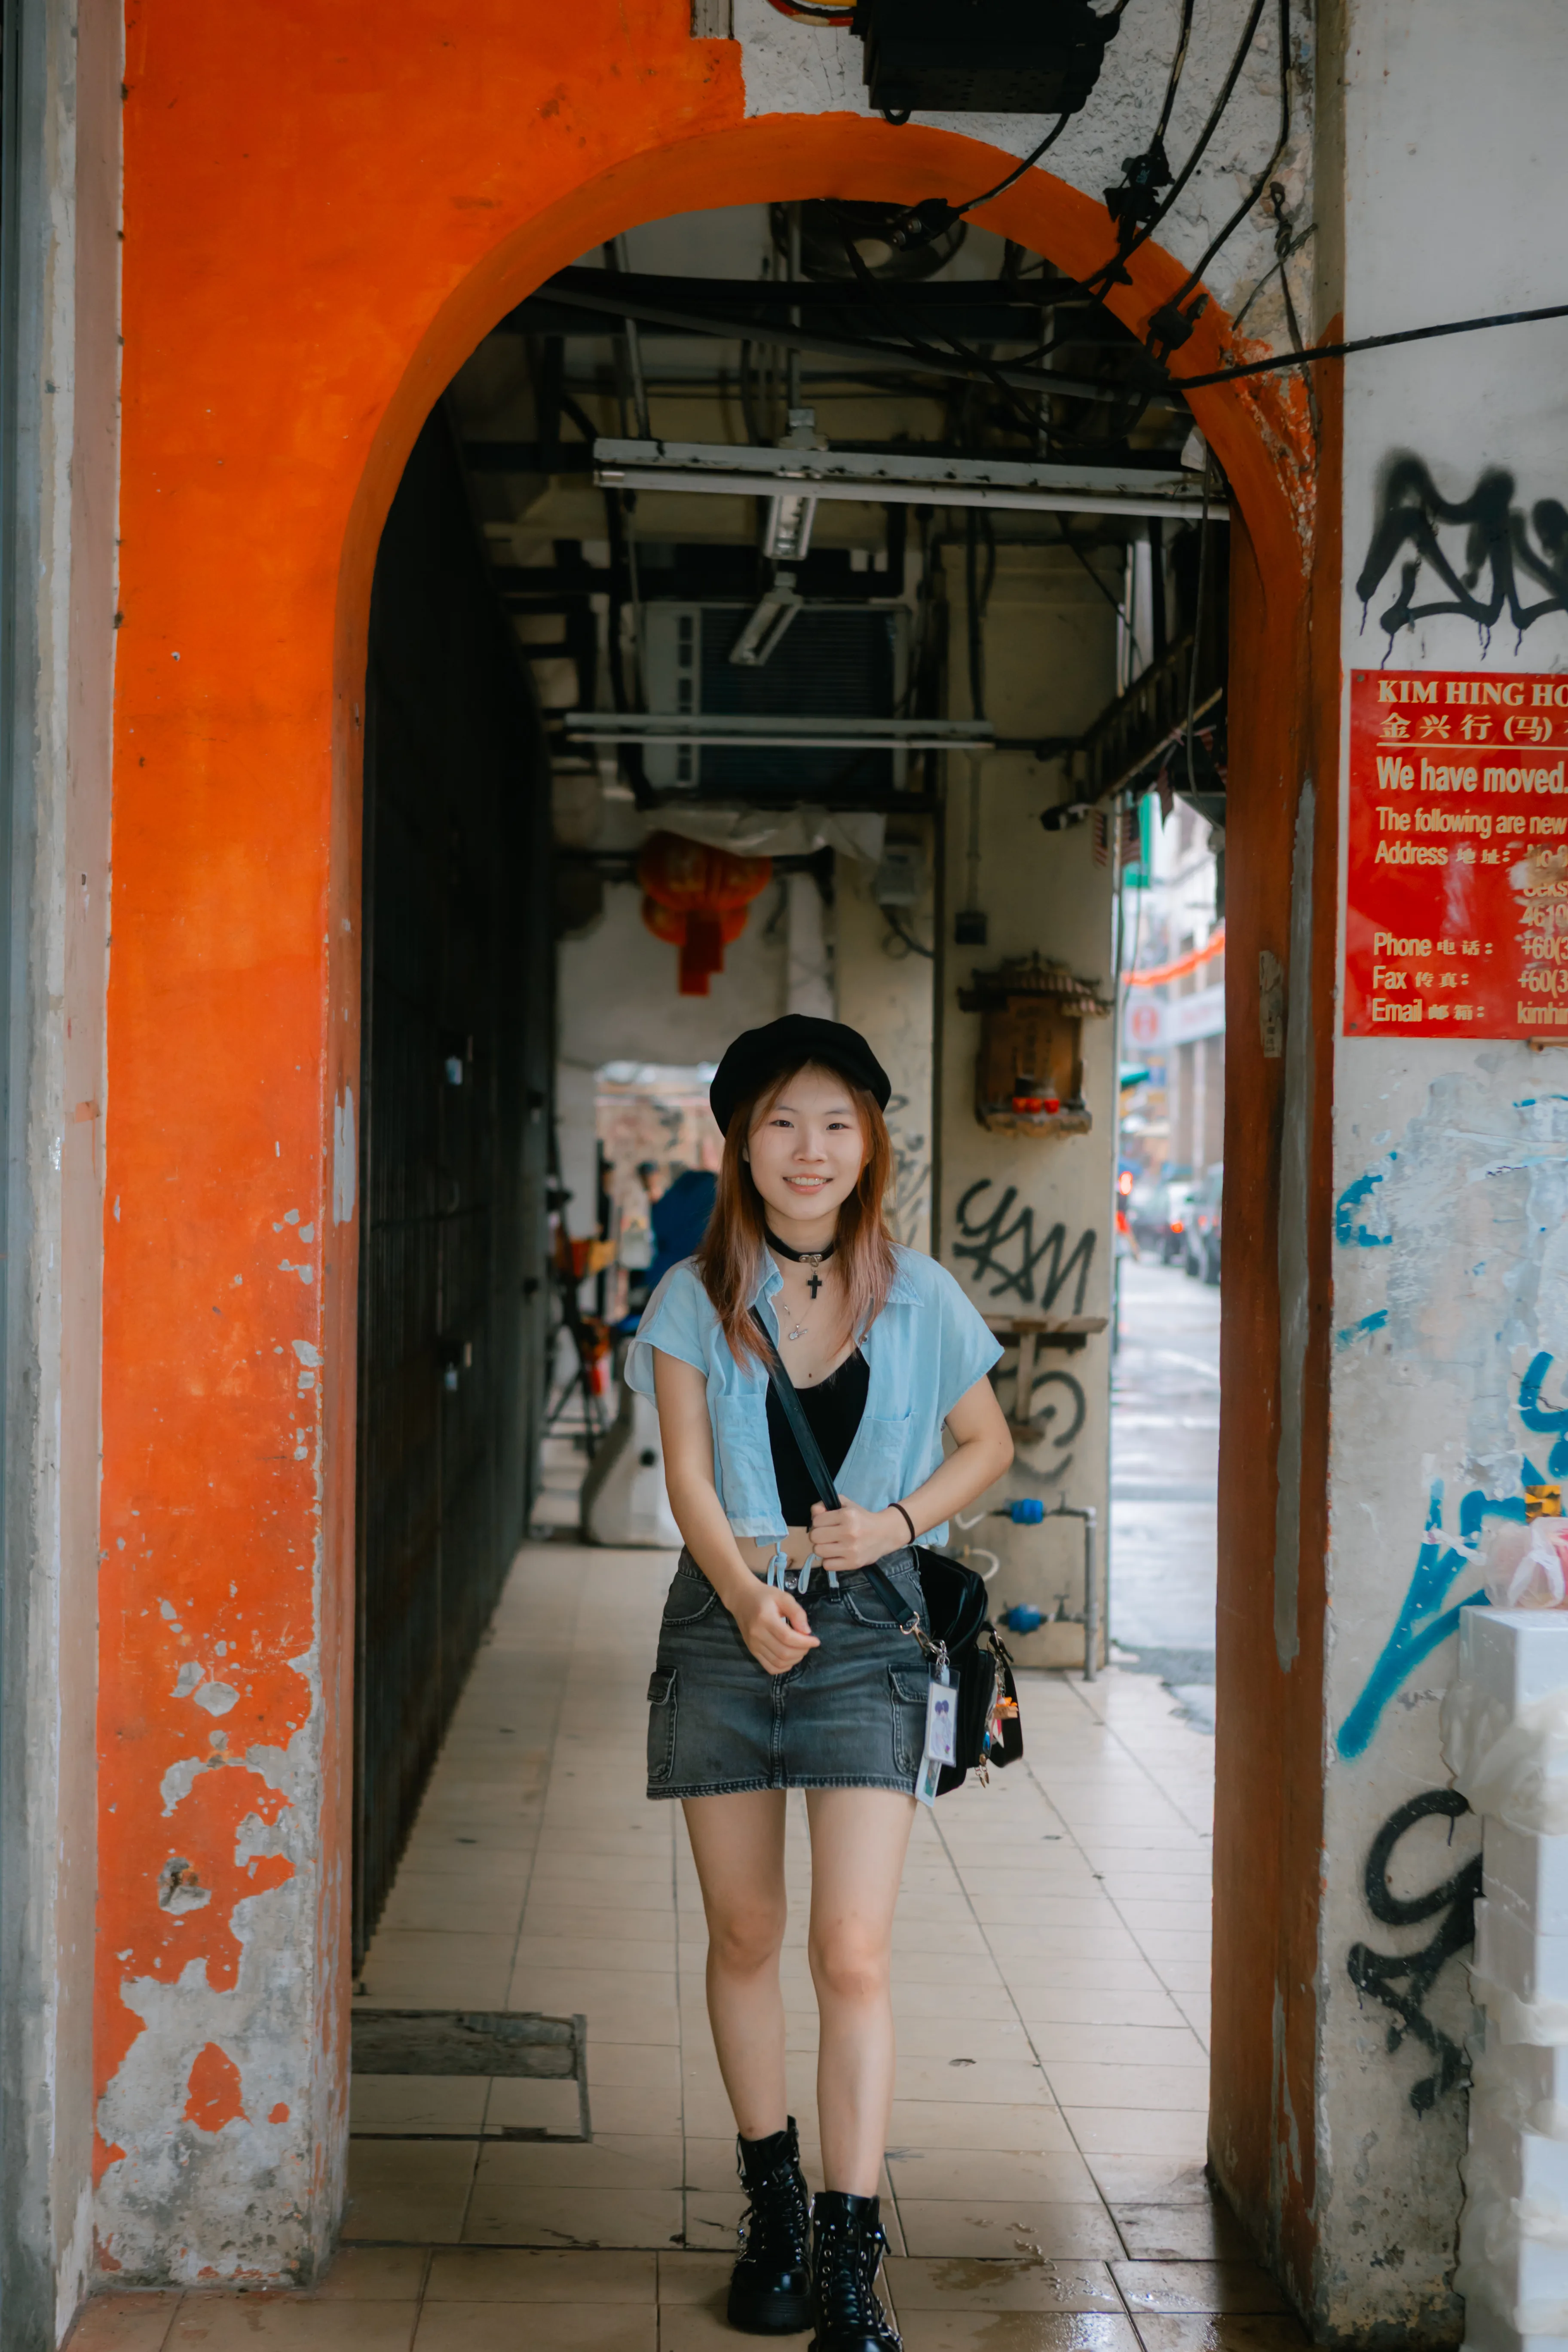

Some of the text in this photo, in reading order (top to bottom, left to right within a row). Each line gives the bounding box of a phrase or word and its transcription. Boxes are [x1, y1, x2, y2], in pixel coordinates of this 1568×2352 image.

[1377, 680, 1439, 704] KIM
[1444, 682, 1525, 706] HING
[1376, 756, 1568, 793] We have moved.
[1376, 806, 1568, 839] The following are new
[1375, 840, 1449, 865] Address
[1374, 932, 1432, 957] Phone
[1373, 965, 1407, 989] Fax
[1372, 998, 1423, 1022] Email
